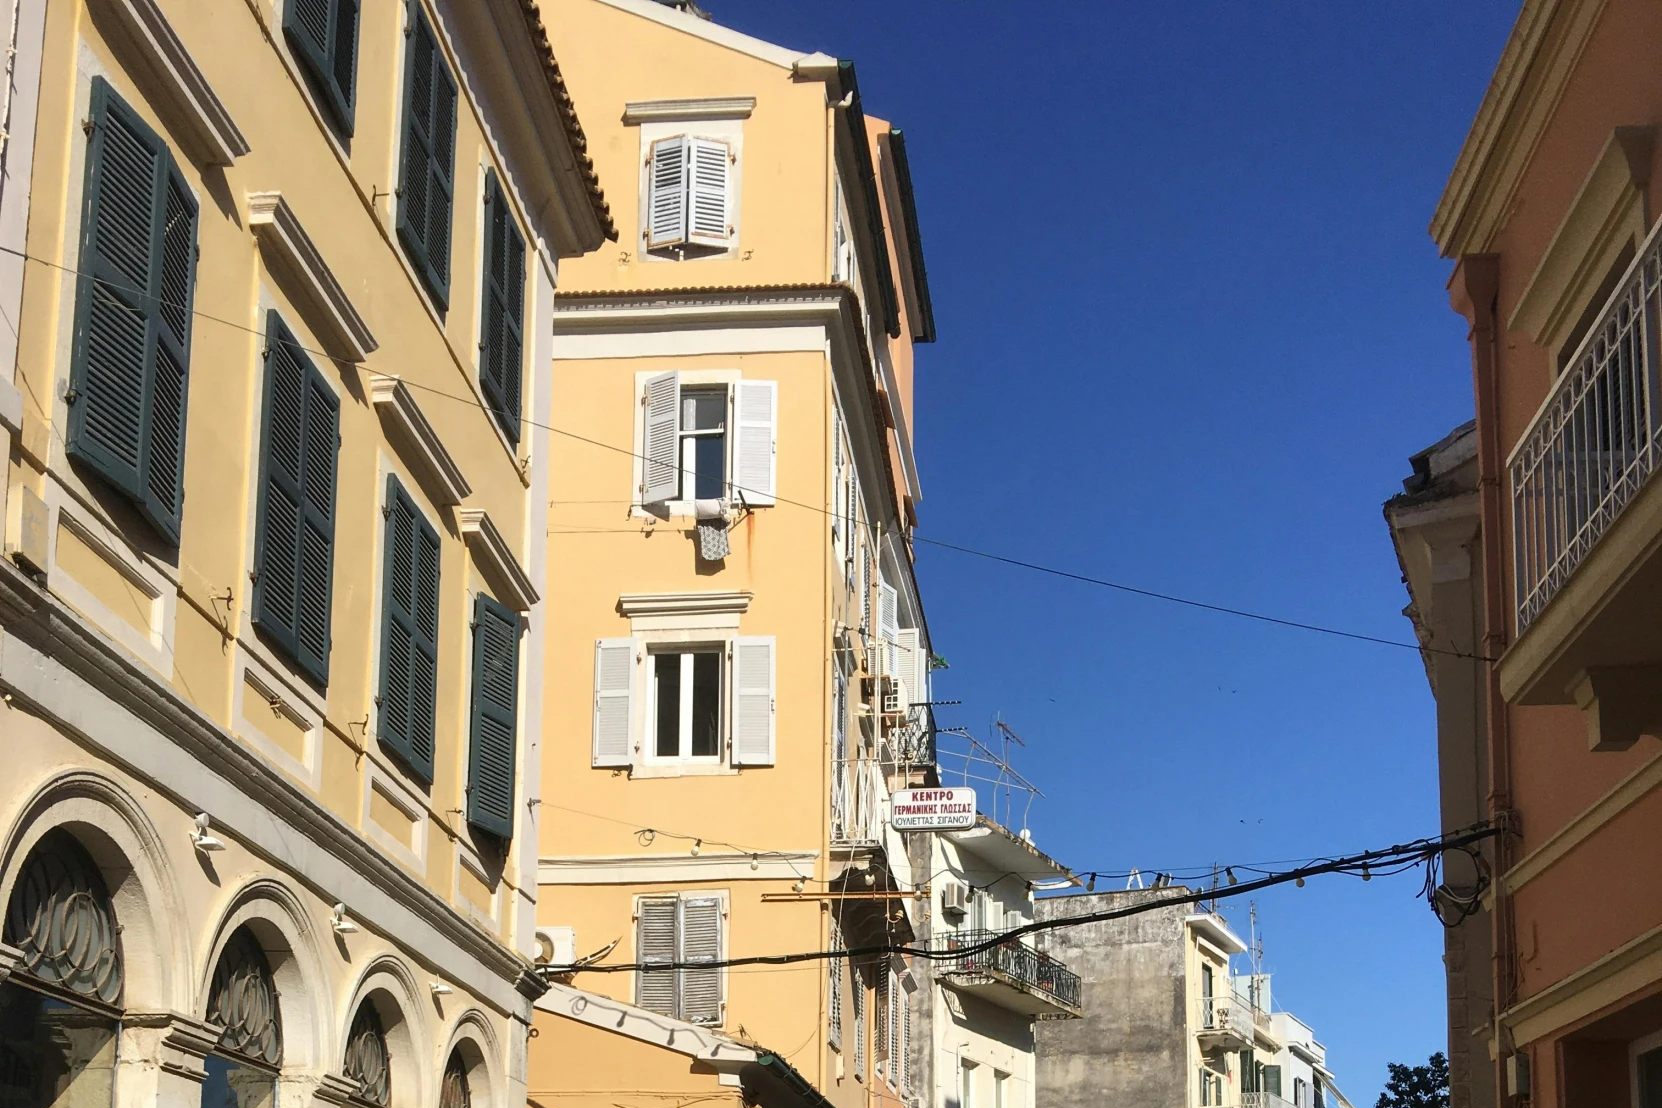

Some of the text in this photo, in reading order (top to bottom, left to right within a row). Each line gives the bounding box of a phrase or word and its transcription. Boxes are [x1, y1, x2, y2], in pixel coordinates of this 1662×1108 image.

[912, 790, 954, 802] ΚΕΝΤΡΟ
[894, 803, 972, 815] ΓΕΡΜΑΝΙΚΗΣ ΓΛΩΣΣΑΣ
[895, 815, 970, 826] ΙΟΥΛΙΕΤΤΑΣ ΣΙΓΑΝΟΥ
